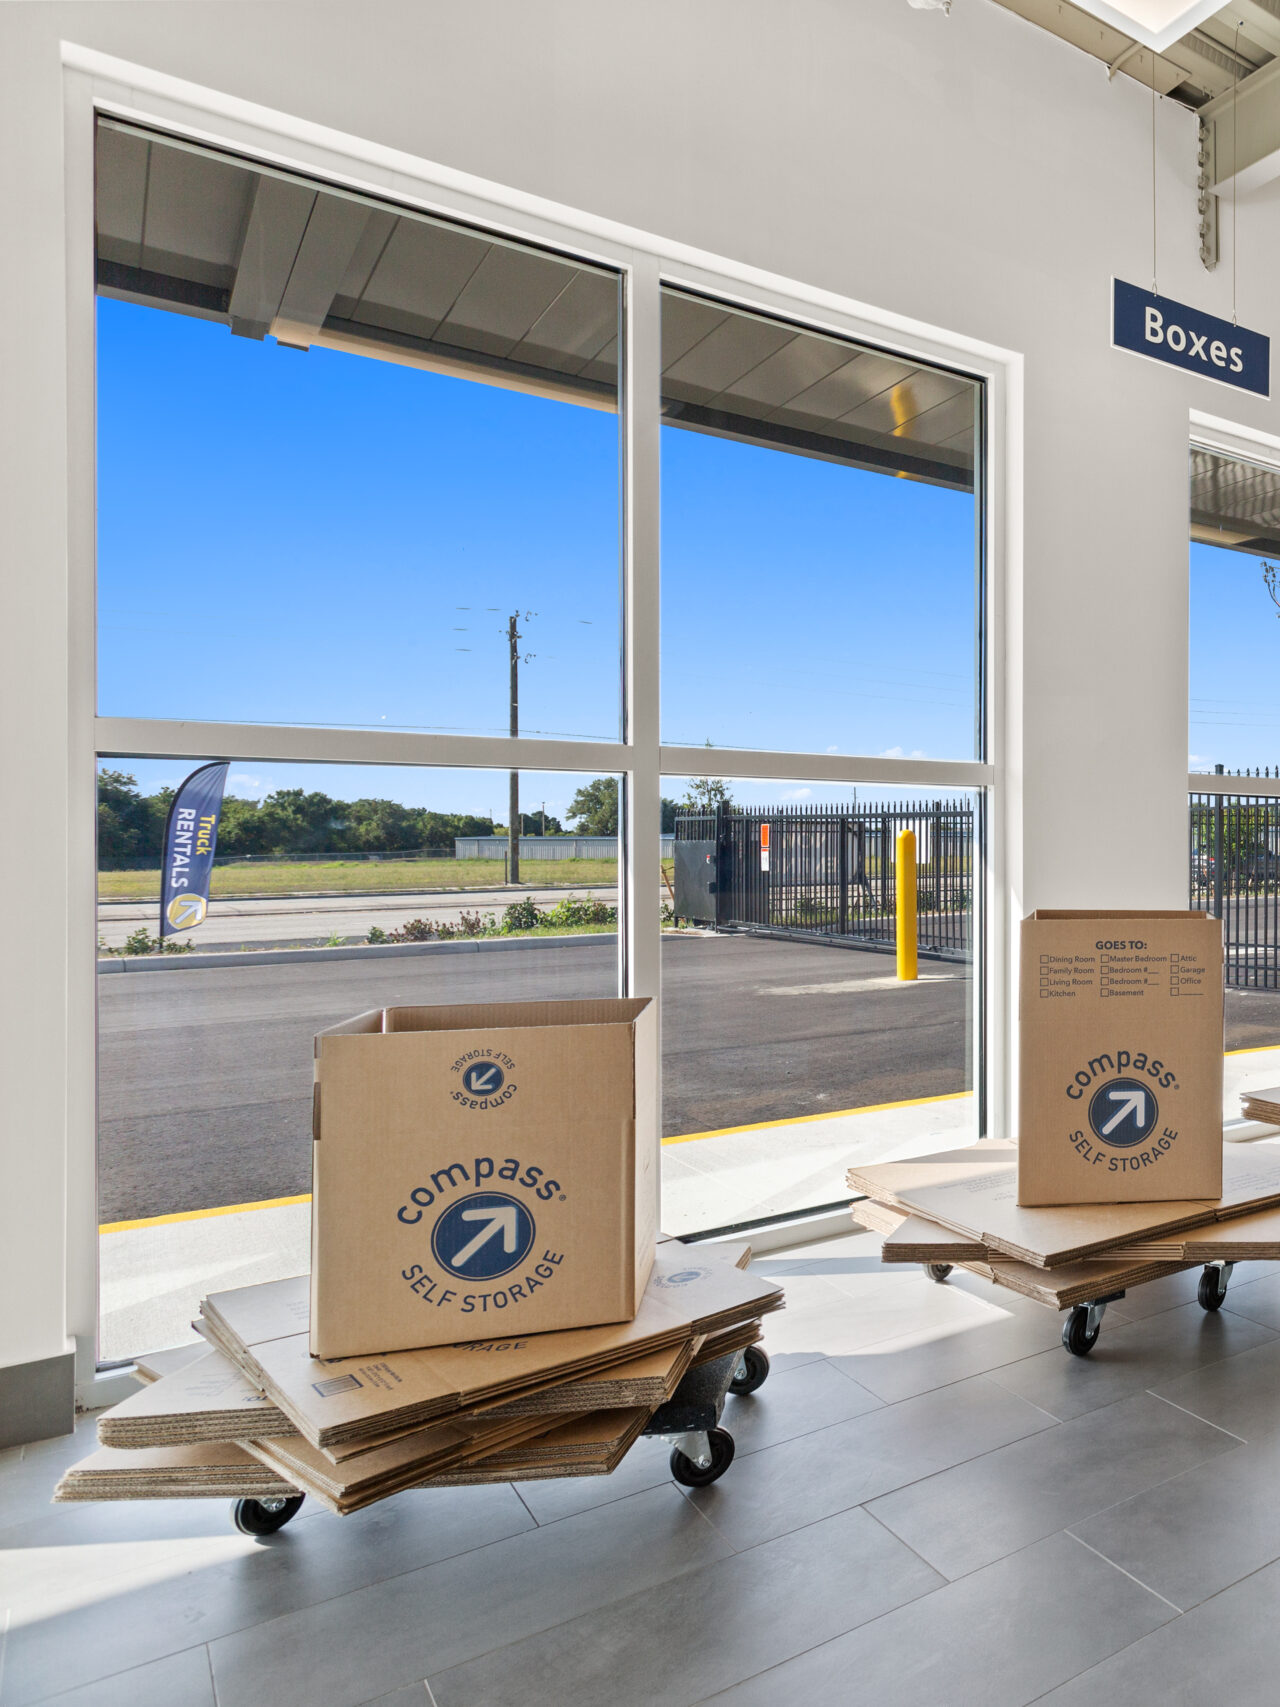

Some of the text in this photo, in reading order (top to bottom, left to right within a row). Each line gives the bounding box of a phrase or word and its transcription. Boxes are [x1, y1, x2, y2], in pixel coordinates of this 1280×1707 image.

[1145, 306, 1243, 373] Boxes
[196, 814, 216, 855] Truck
[170, 808, 196, 888] RENTALS
[1095, 940, 1148, 950] GOES TO:
[1050, 955, 1096, 965] Dining Room
[1109, 955, 1133, 963] Master
[1050, 966, 1095, 976] Family Room
[1109, 966, 1142, 974] Bedroom
[1180, 966, 1206, 974] Garage
[1050, 978, 1071, 987] Living
[1180, 977, 1202, 985] Office
[1050, 989, 1076, 997] Kitchen
[1109, 989, 1144, 997] Basement
[451, 1049, 516, 1073] SELF STORAGE
[1066, 1050, 1176, 1100] compass
[452, 1083, 518, 1110] compass
[1069, 1127, 1178, 1172] SELF STORAGE
[397, 1156, 562, 1226] compass
[401, 1249, 565, 1313] SELF STORAGE
[452, 1341, 528, 1352] RAGE
